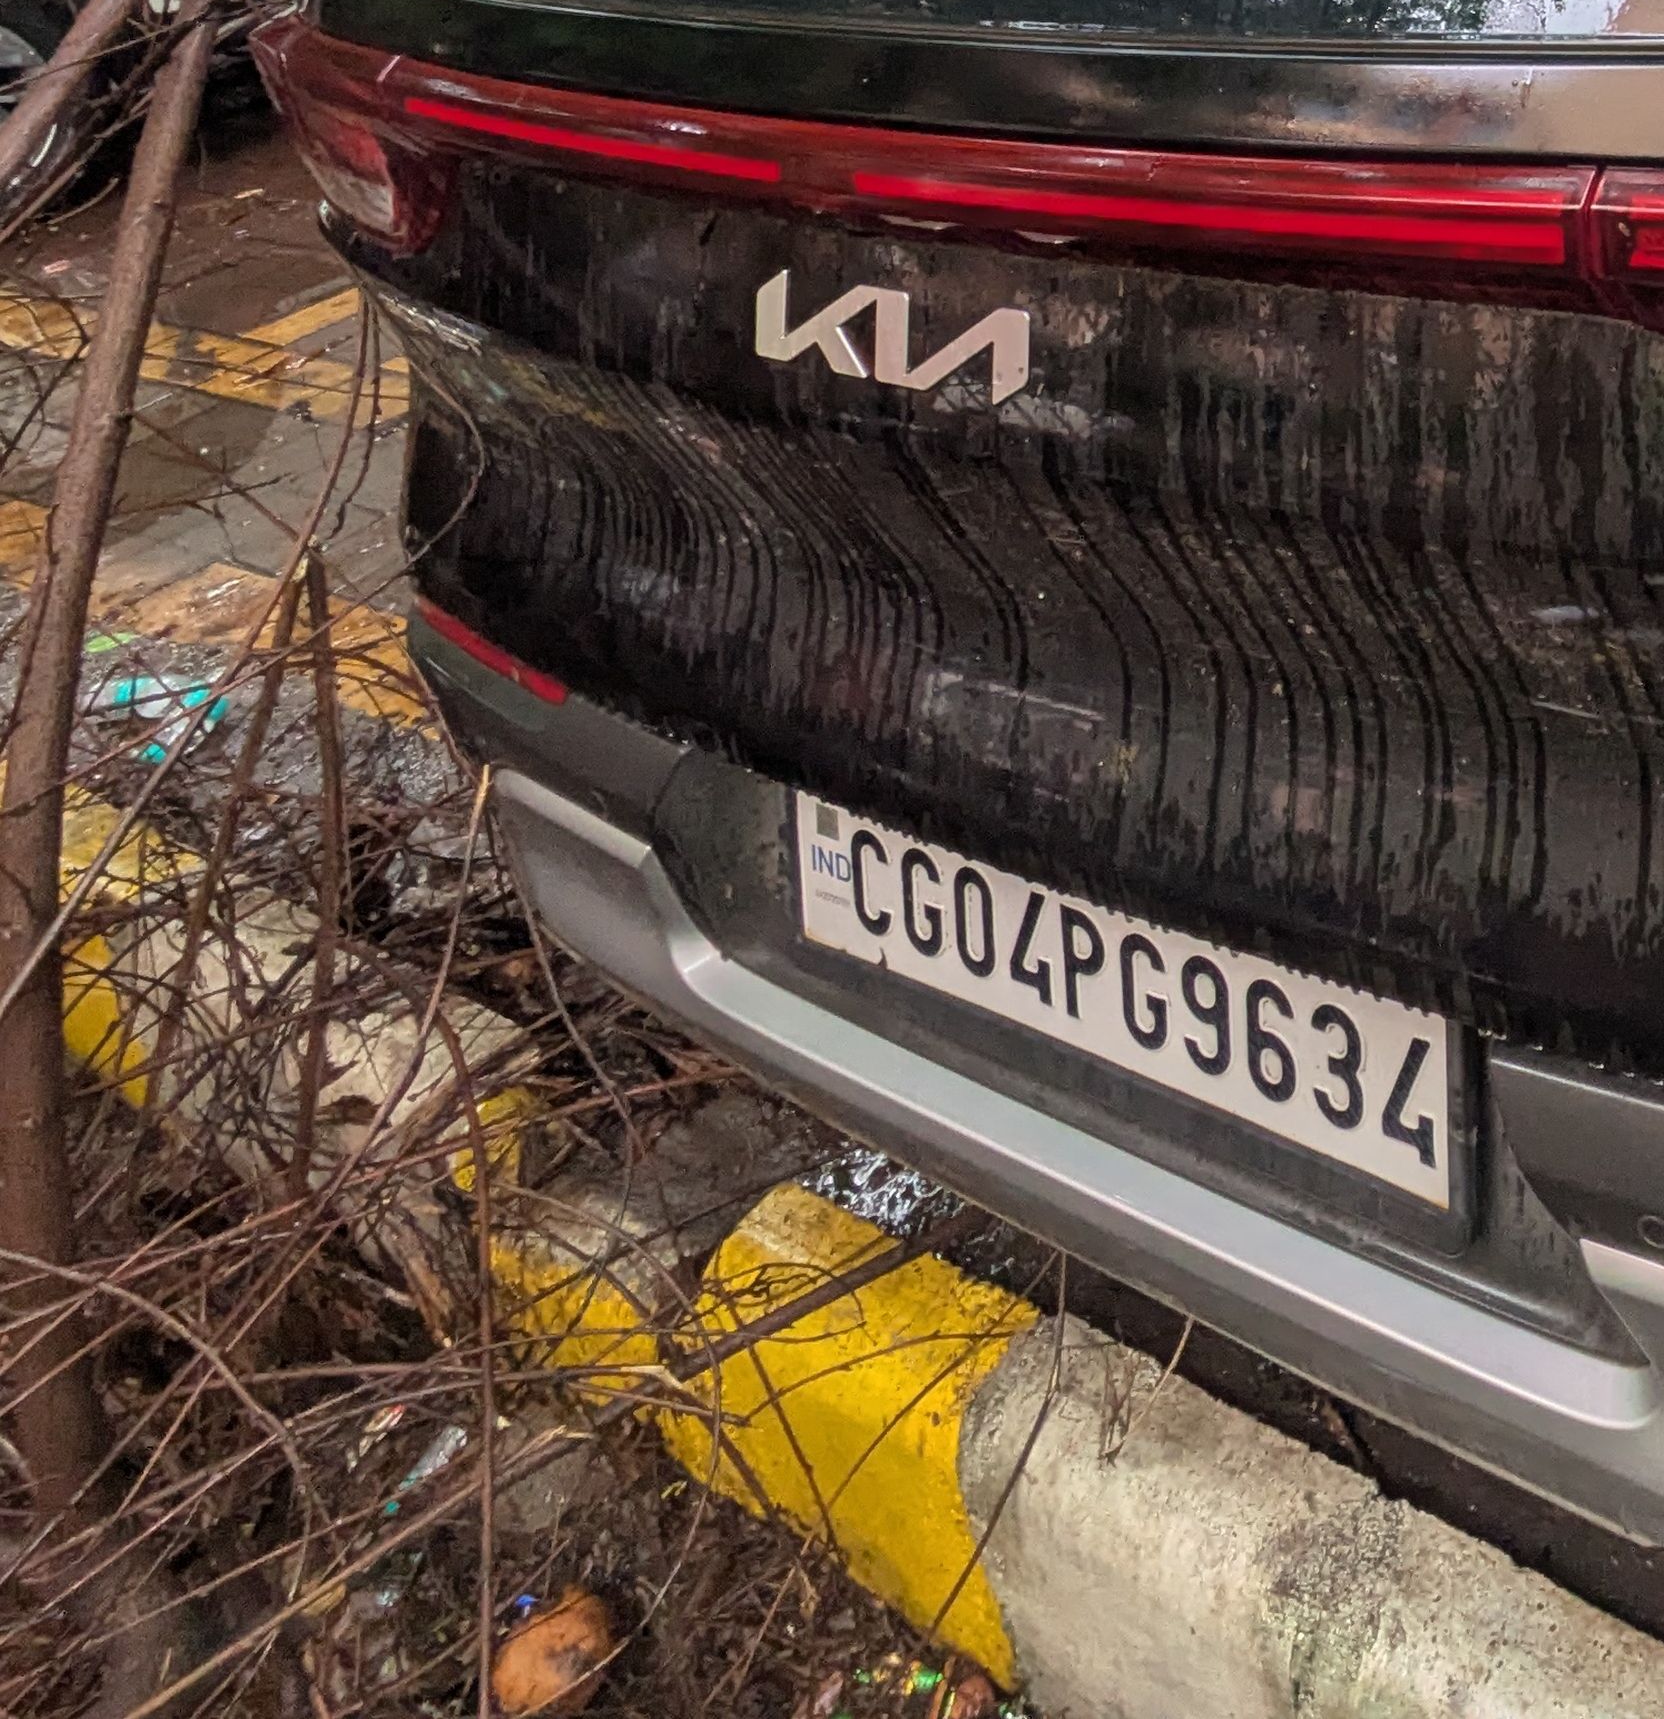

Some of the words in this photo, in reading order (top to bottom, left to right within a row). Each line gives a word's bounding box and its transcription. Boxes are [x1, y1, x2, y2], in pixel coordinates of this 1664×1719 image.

[755, 268, 1030, 406] KIA
[811, 843, 852, 882] IND
[850, 829, 1437, 1169] CG04PG9634
